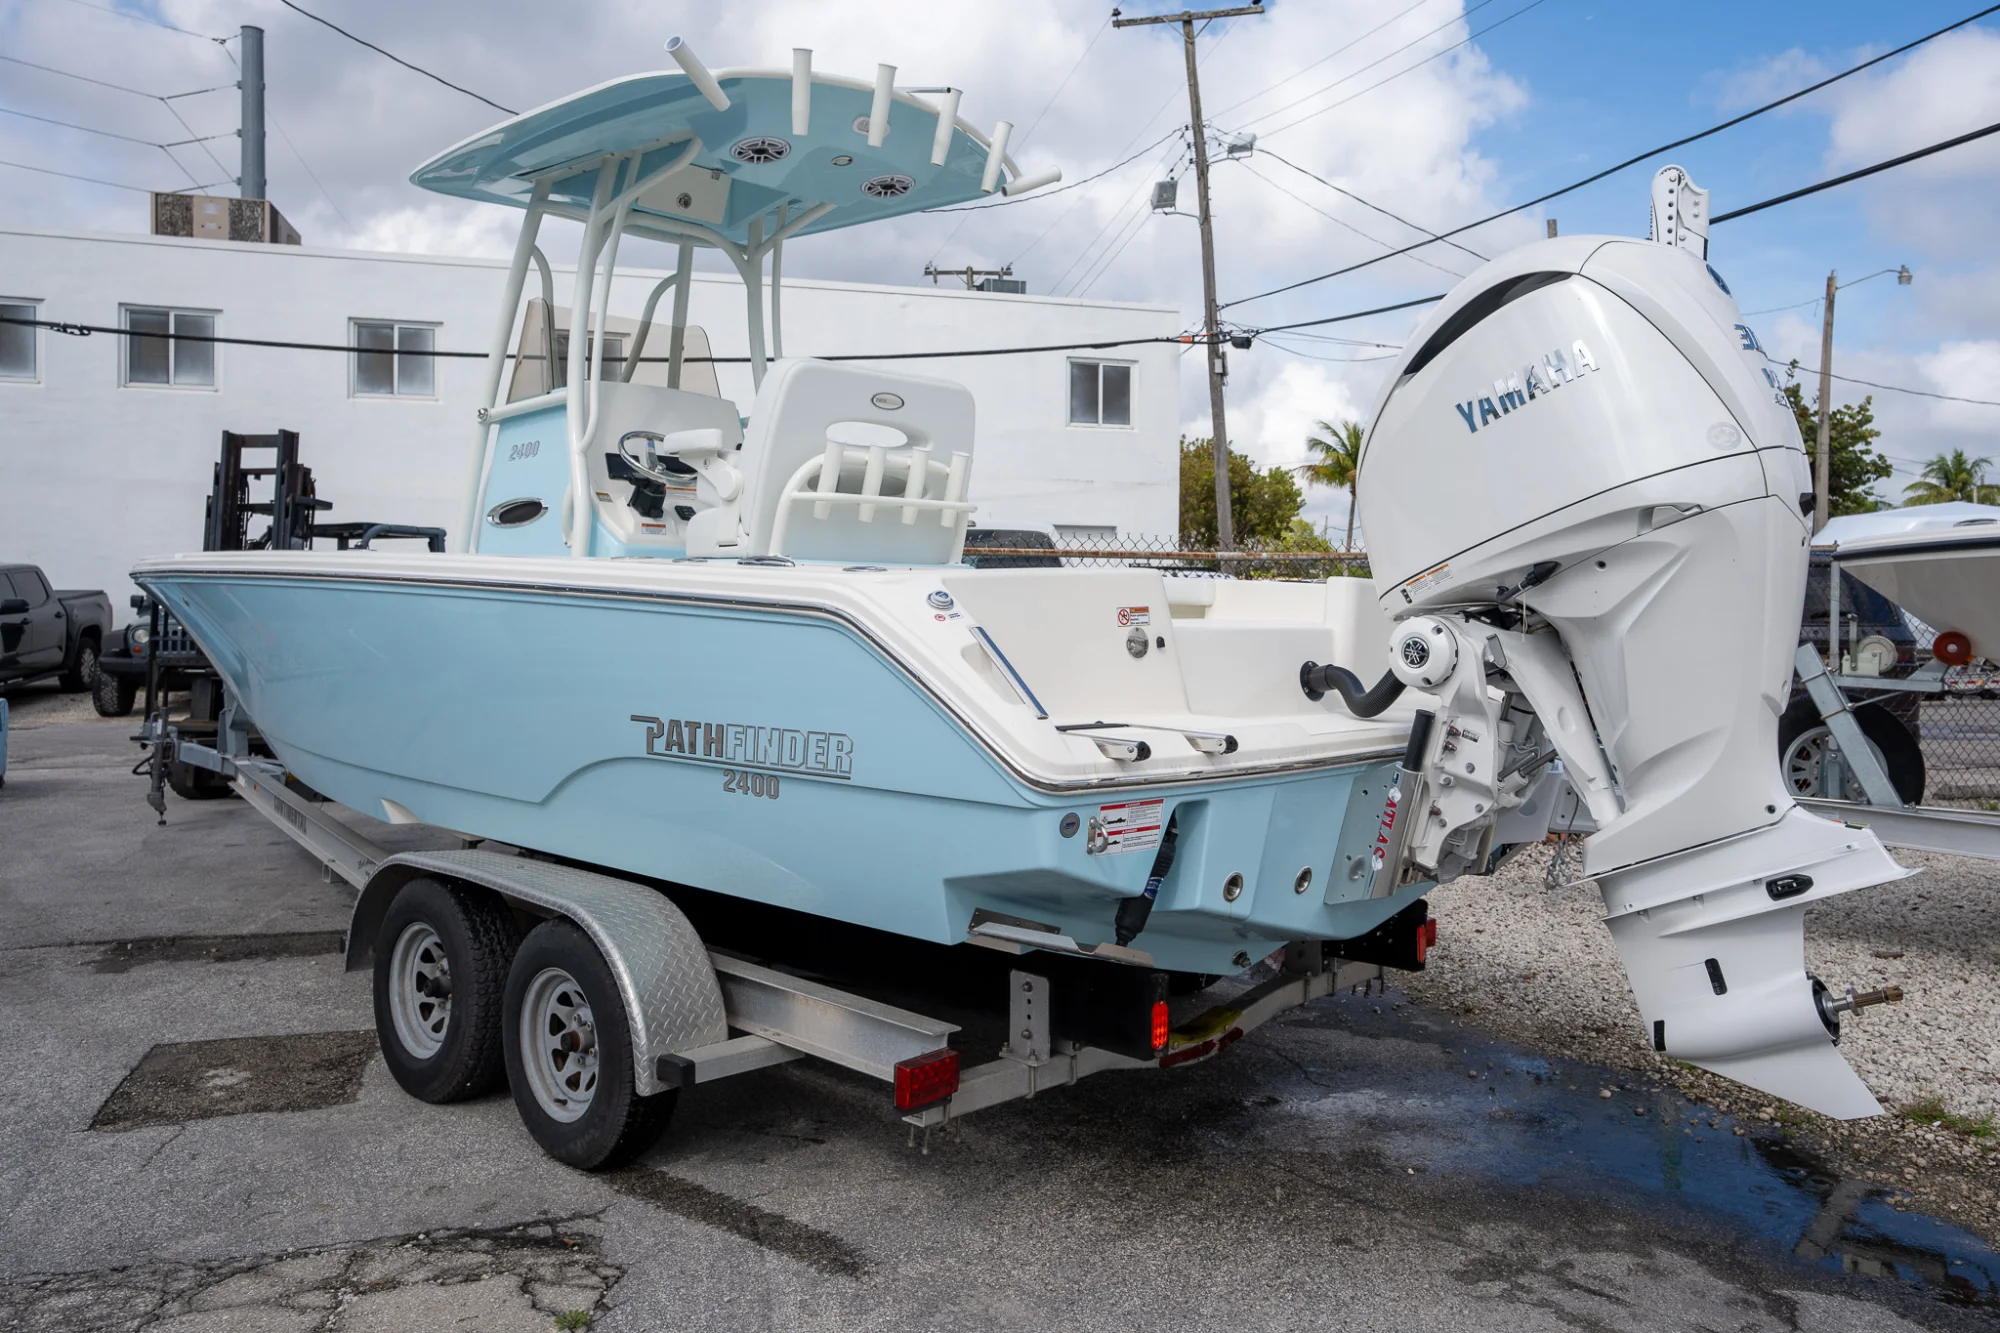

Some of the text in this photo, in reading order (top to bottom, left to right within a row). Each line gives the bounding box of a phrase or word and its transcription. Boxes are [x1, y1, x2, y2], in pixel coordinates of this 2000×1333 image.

[1454, 339, 1601, 434] YAMAHA
[508, 440, 541, 462] 2400
[630, 714, 854, 776] PATHFINDER
[723, 769, 780, 800] 2400
[1373, 797, 1398, 860] ATLAS
